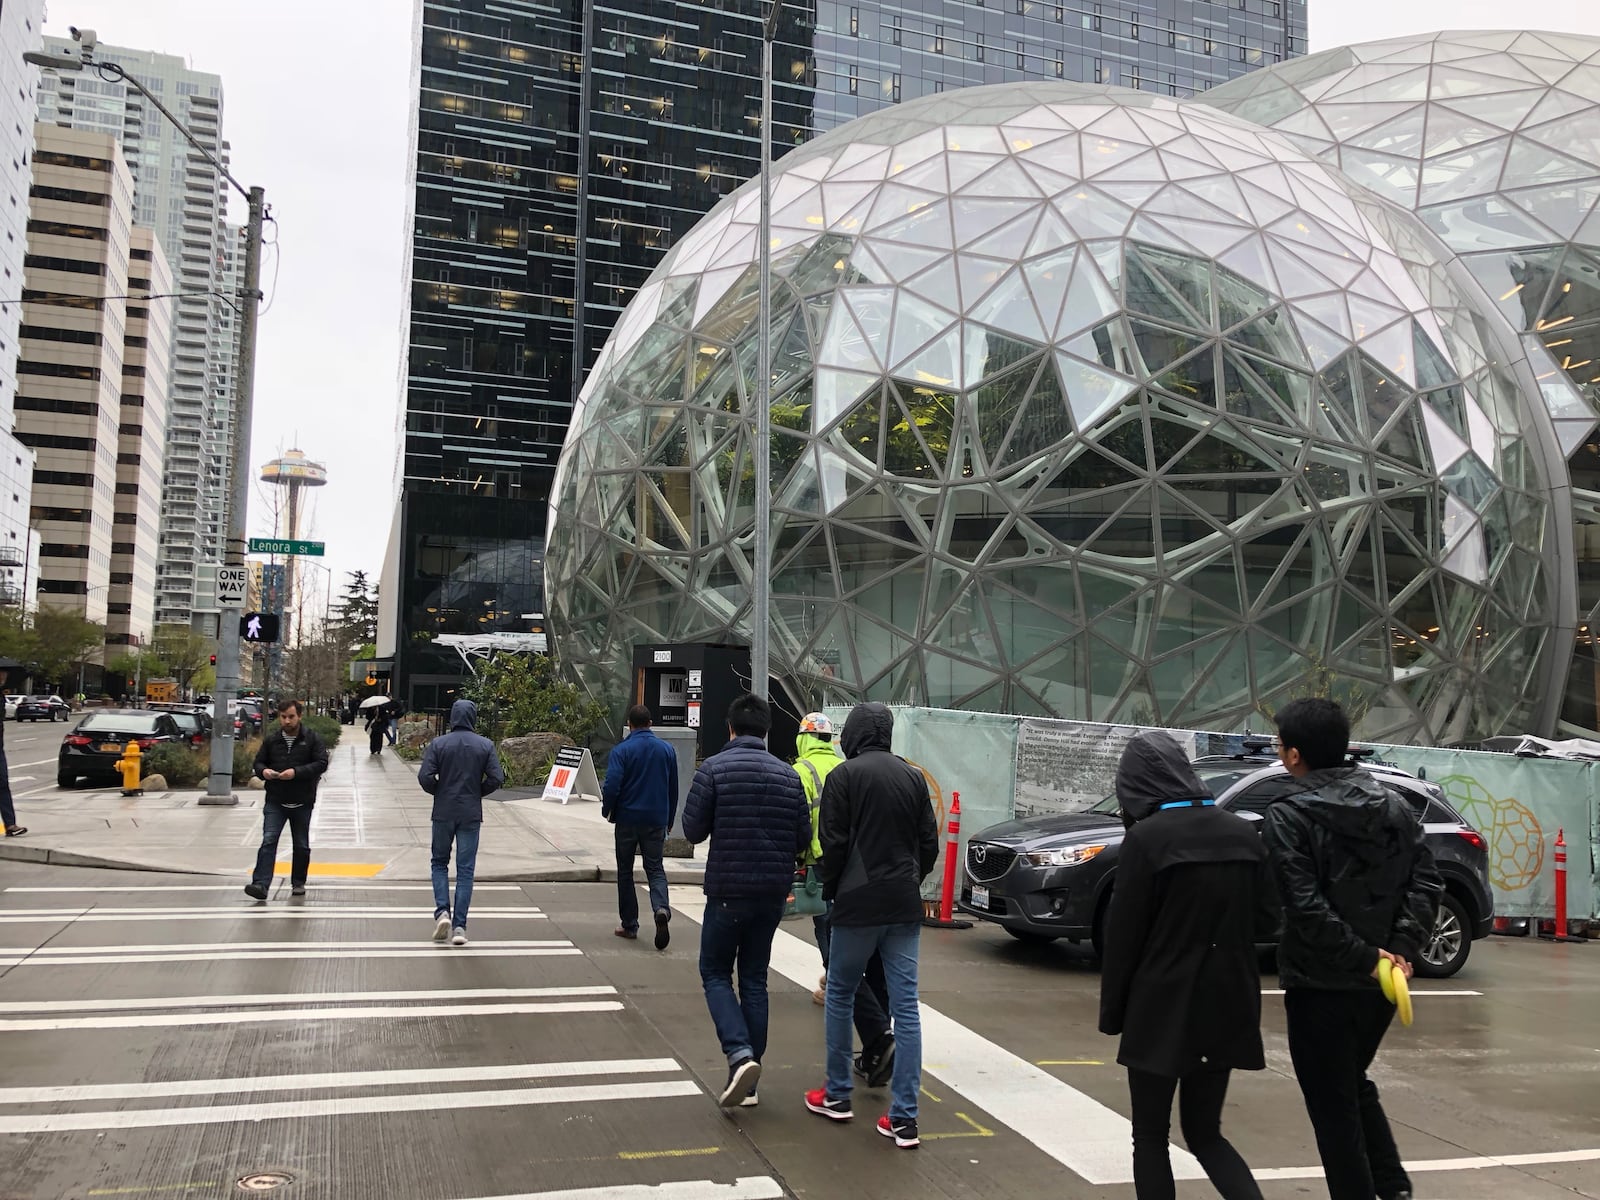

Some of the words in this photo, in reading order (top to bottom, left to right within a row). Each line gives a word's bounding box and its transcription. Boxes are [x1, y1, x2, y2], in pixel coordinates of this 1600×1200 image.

[252, 540, 290, 552] Lenora
[299, 546, 308, 554] St
[220, 570, 245, 580] ONE
[219, 582, 246, 592] WAY
